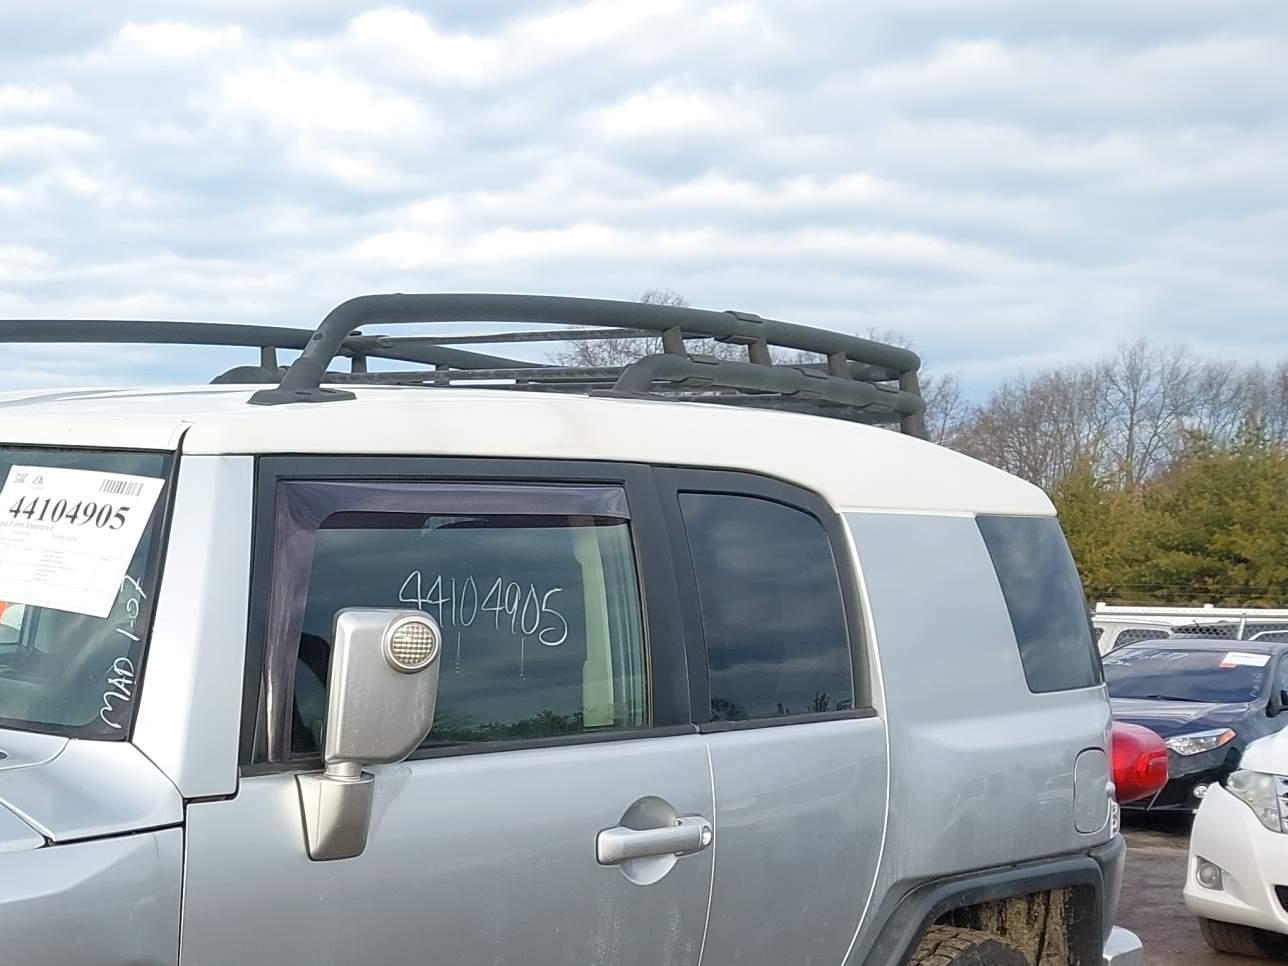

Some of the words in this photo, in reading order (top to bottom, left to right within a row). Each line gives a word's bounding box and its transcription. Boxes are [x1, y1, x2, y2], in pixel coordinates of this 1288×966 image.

[9, 496, 130, 530] 44104905
[399, 570, 569, 646] 44104905
[99, 656, 137, 729] MAD
